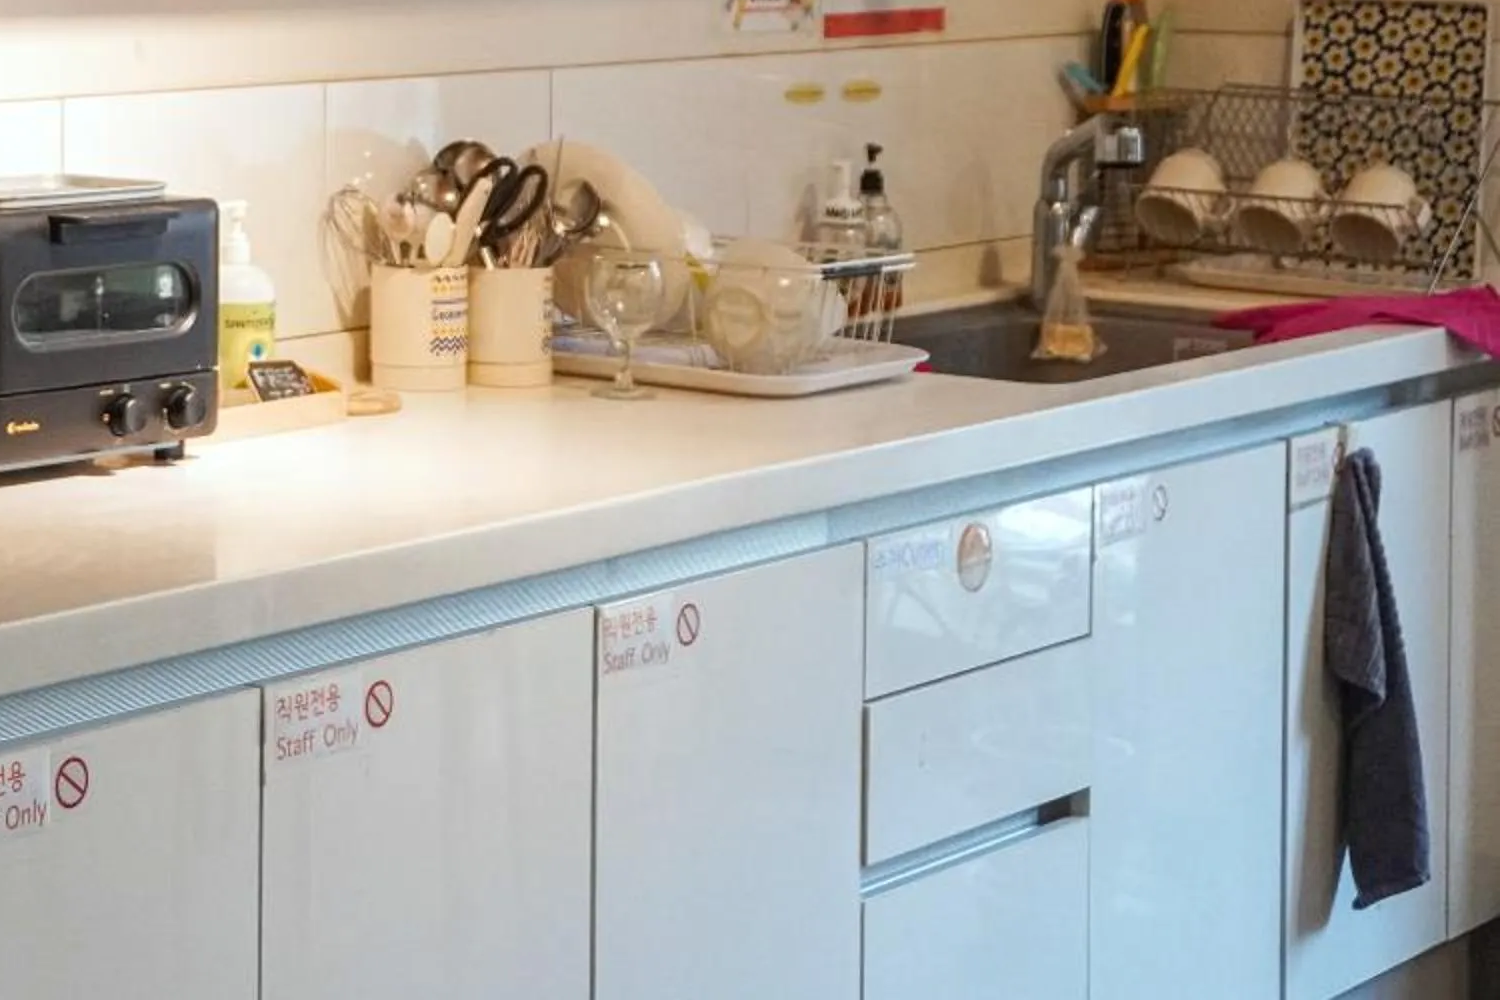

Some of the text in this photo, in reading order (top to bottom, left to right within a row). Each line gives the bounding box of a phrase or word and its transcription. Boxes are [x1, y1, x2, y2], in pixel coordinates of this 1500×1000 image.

[277, 684, 341, 723] 직원전용
[276, 718, 359, 761] Staff Only
[5, 800, 48, 831] Only
